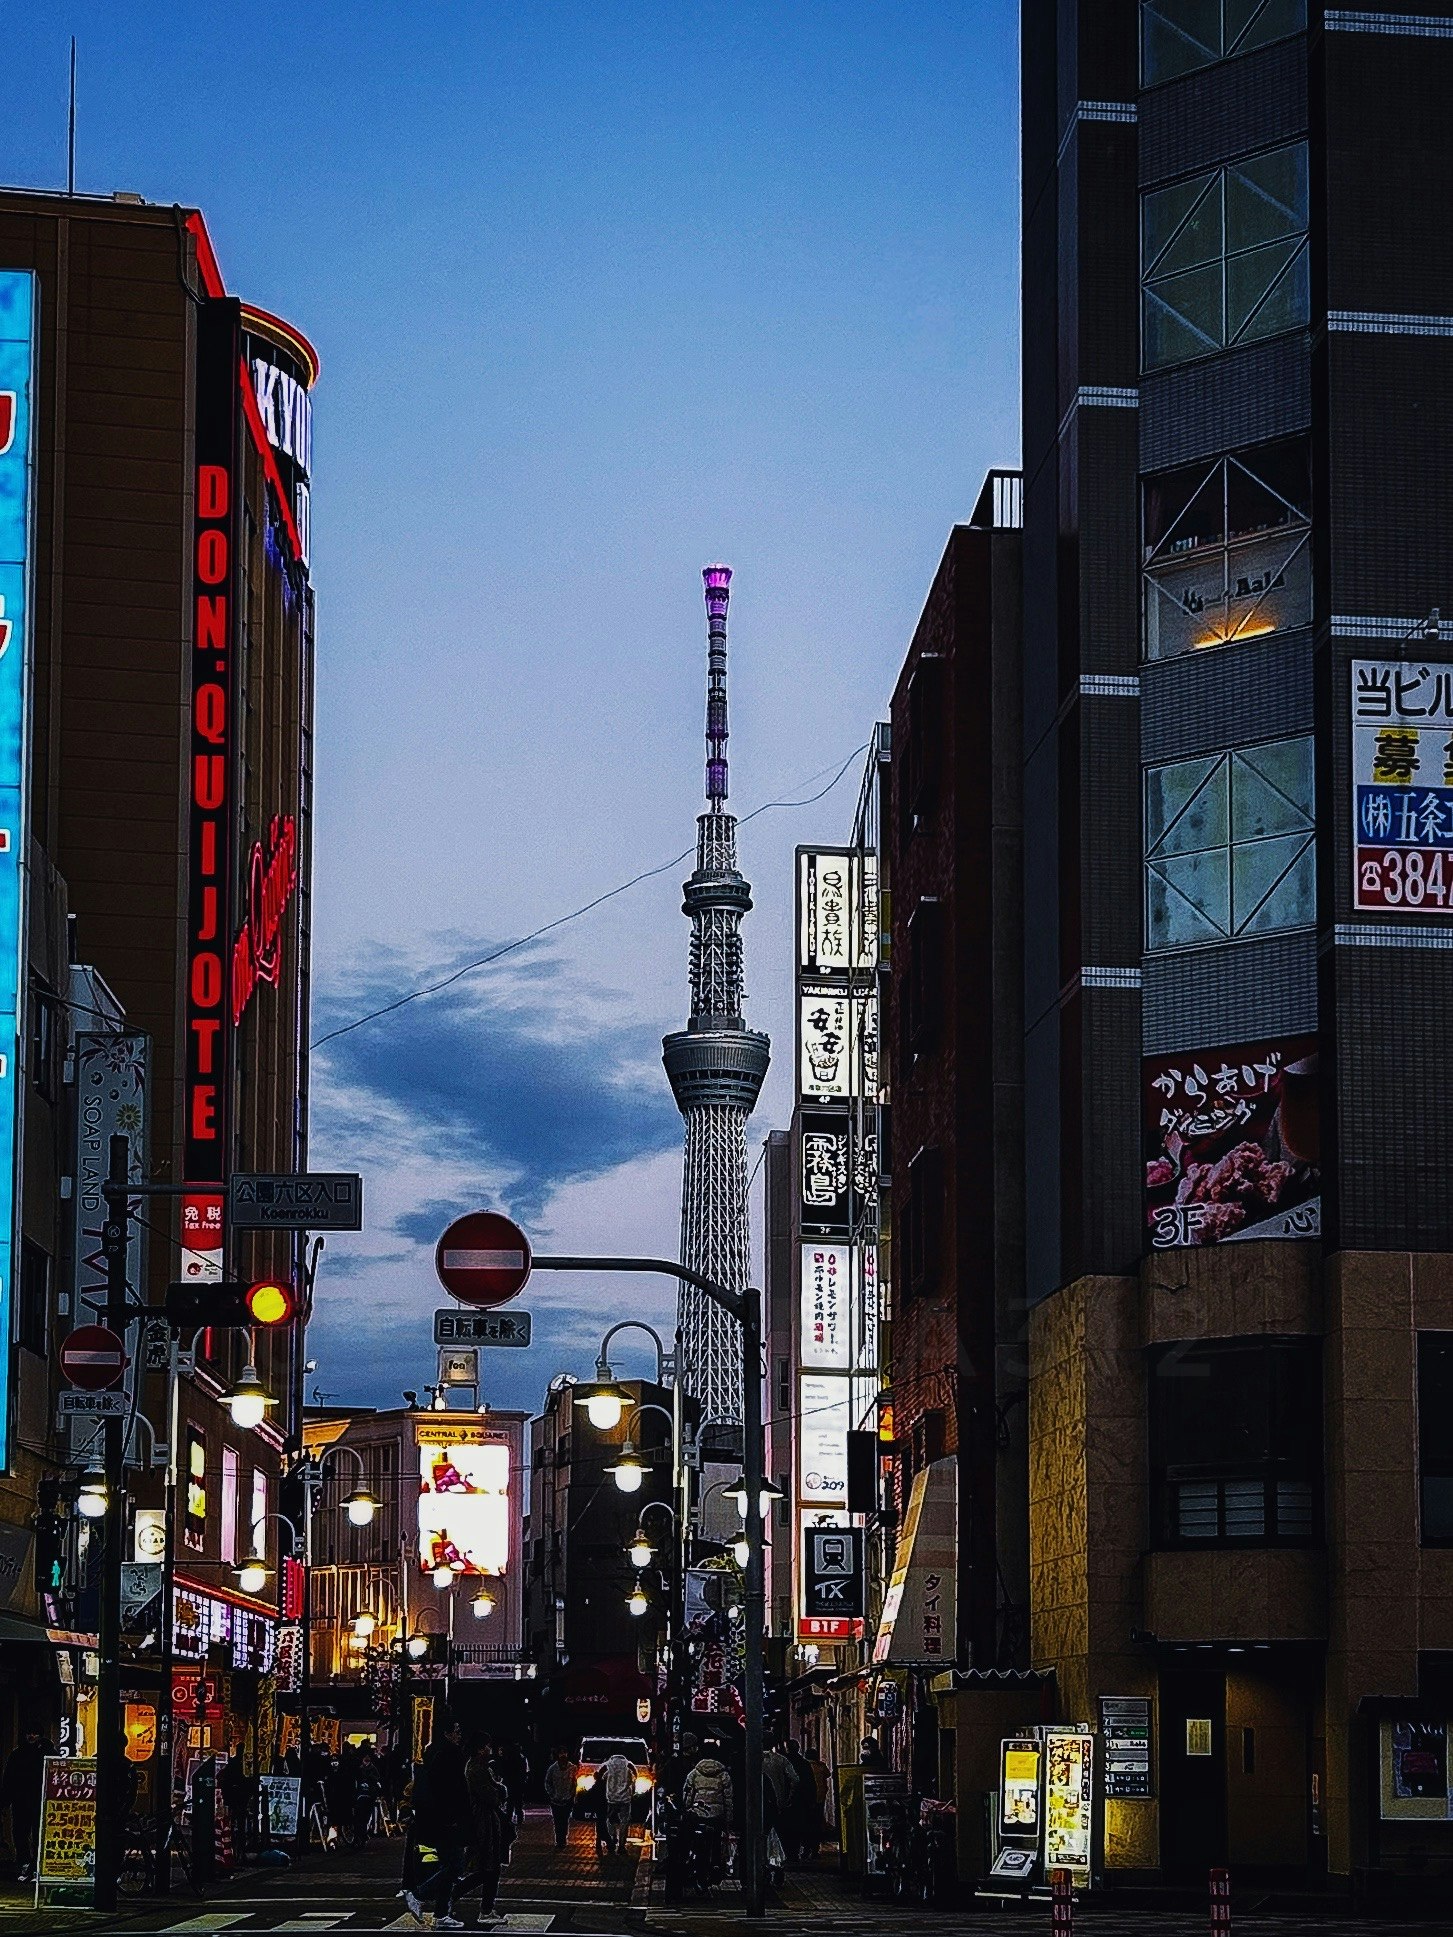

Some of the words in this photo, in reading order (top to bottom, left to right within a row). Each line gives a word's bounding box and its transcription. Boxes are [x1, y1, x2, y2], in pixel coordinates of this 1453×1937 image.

[1373, 735, 1453, 778] 募
[1383, 851, 1453, 906] 384
[1151, 1051, 1281, 1107] からあげ
[82, 1096, 102, 1153] SOAP
[81, 1158, 100, 1212] LAND
[235, 1182, 351, 1203] 公園六区入口
[184, 1206, 222, 1221] 免税
[1152, 1202, 1207, 1248] 3F
[1282, 1206, 1317, 1234] 心
[438, 1317, 526, 1339] 自転車を除く
[63, 1395, 120, 1411] 自転車を除く
[418, 1430, 457, 1438] CENTRAL
[814, 1580, 852, 1599] TX
[810, 1620, 840, 1633] B1F
